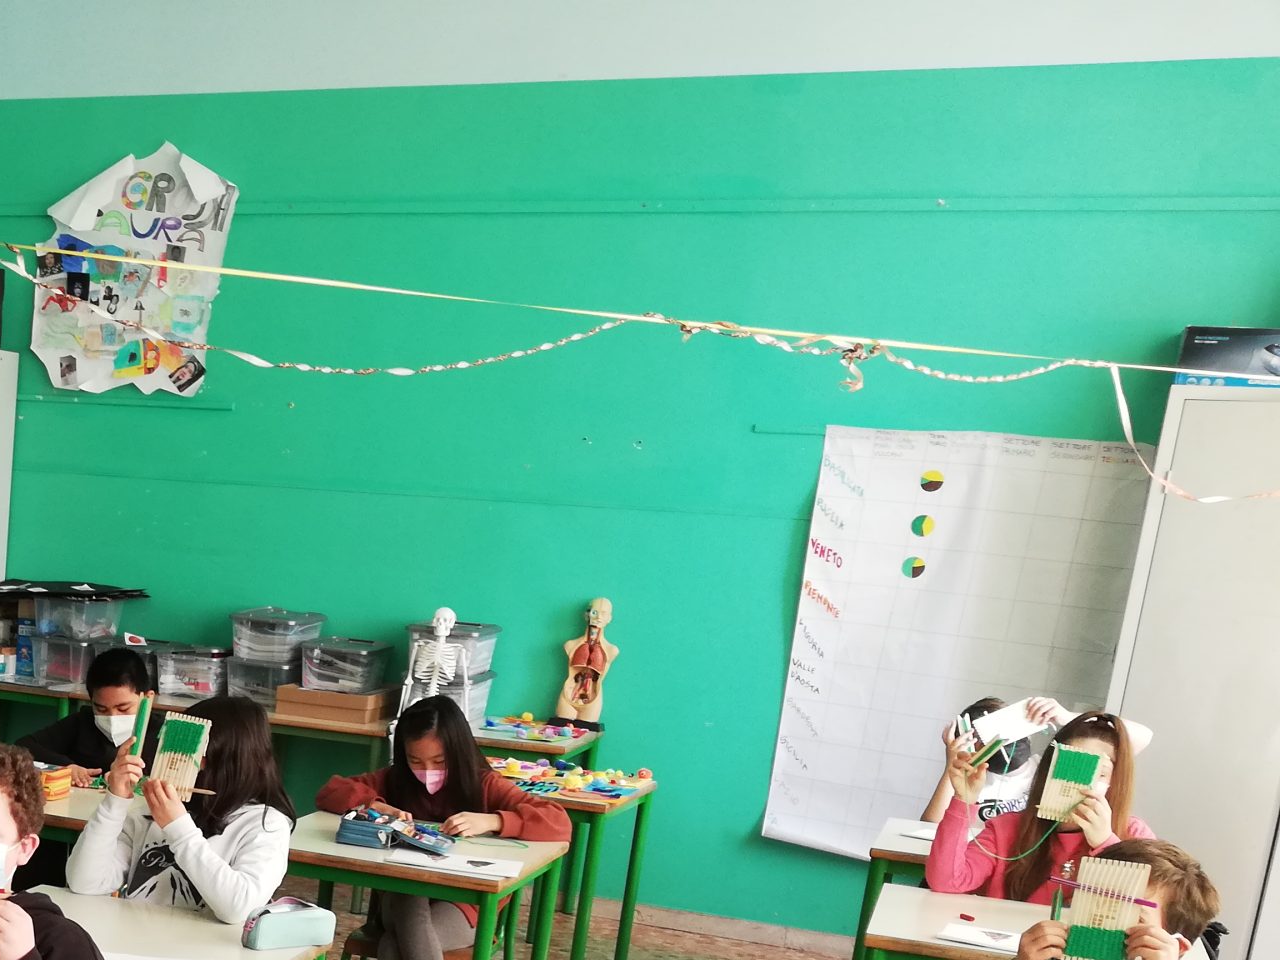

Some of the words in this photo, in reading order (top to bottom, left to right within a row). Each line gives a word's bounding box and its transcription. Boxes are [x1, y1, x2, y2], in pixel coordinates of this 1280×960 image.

[811, 538, 842, 568] VENETO
[804, 580, 840, 618] PIEMONTE
[799, 618, 824, 658] LIGURIA
[792, 657, 816, 674] VALLE
[790, 671, 820, 695] D'AOSTA
